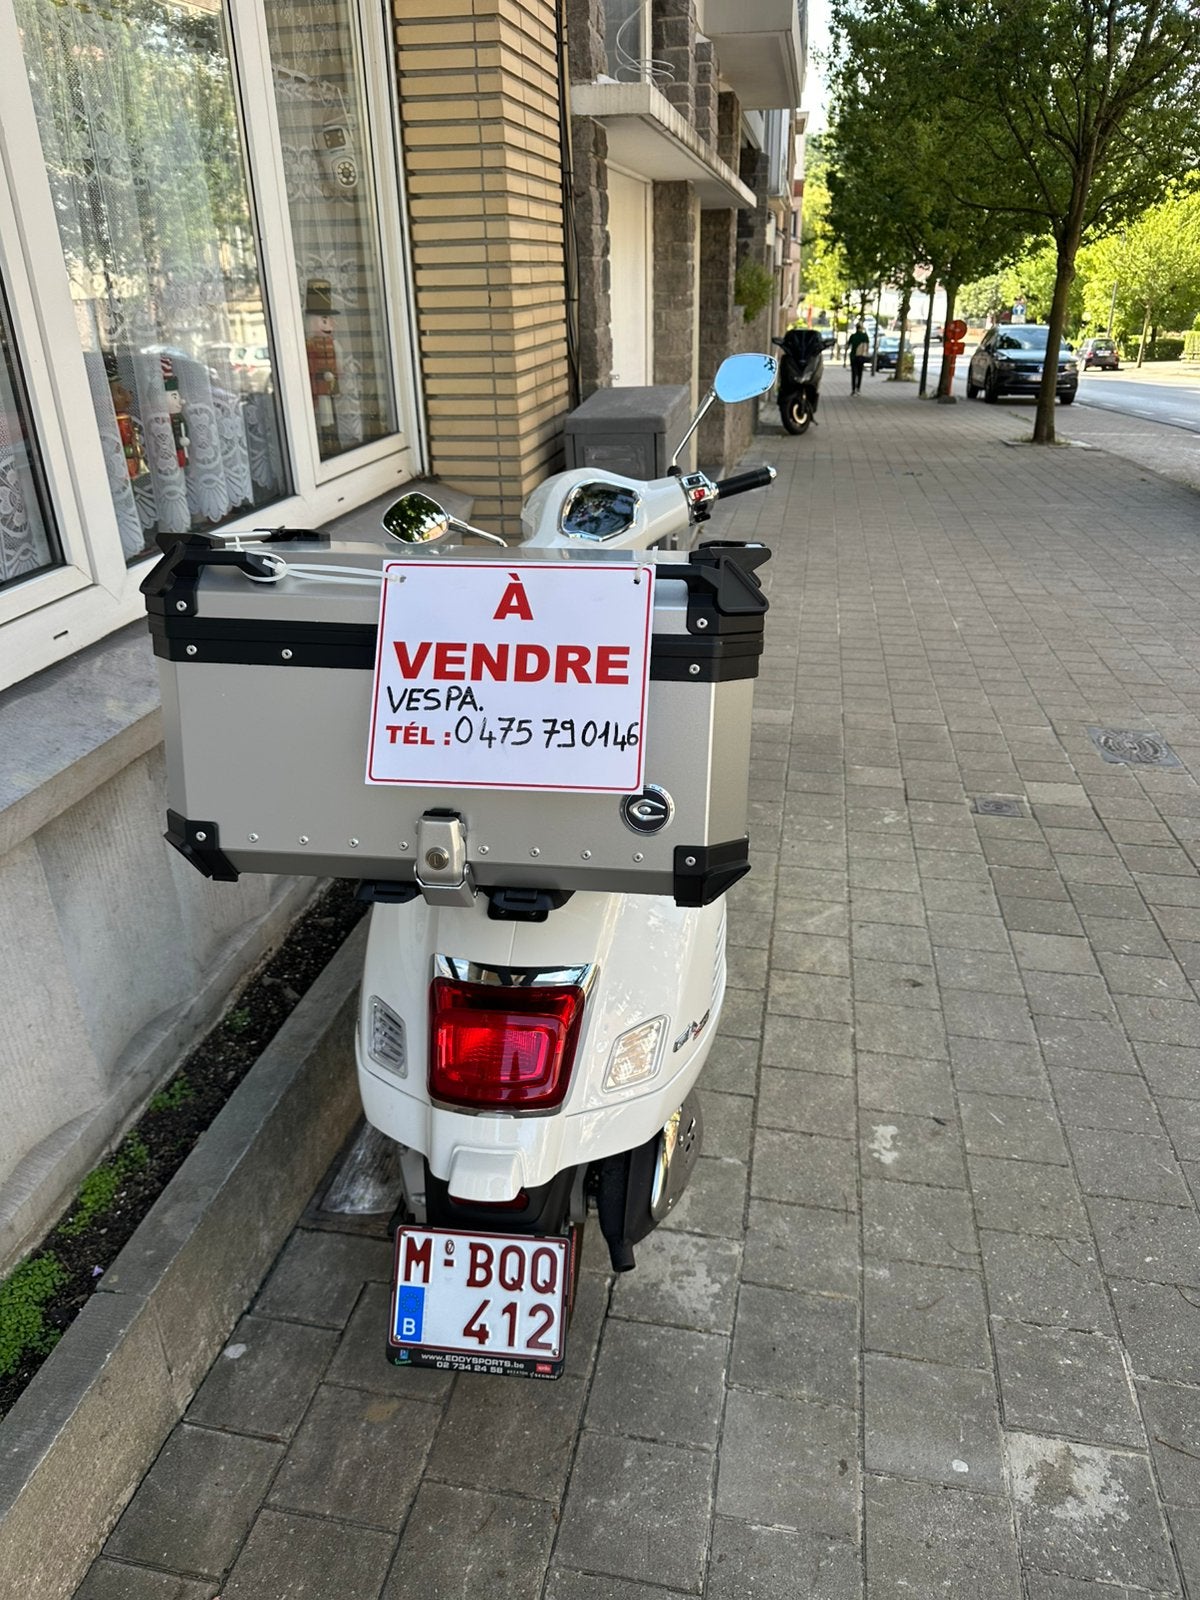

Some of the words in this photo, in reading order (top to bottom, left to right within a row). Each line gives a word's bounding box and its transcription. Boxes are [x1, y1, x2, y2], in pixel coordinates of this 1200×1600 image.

[493, 572, 534, 621] À
[393, 641, 631, 685] VENDRE
[402, 1318, 416, 1336] B
[462, 1299, 556, 1350] 412
[421, 1353, 524, 1369] www.EDDYSPORTS.be
[436, 1361, 450, 1369] 02
[452, 1362, 472, 1371] 734
[474, 1364, 488, 1373] 24
